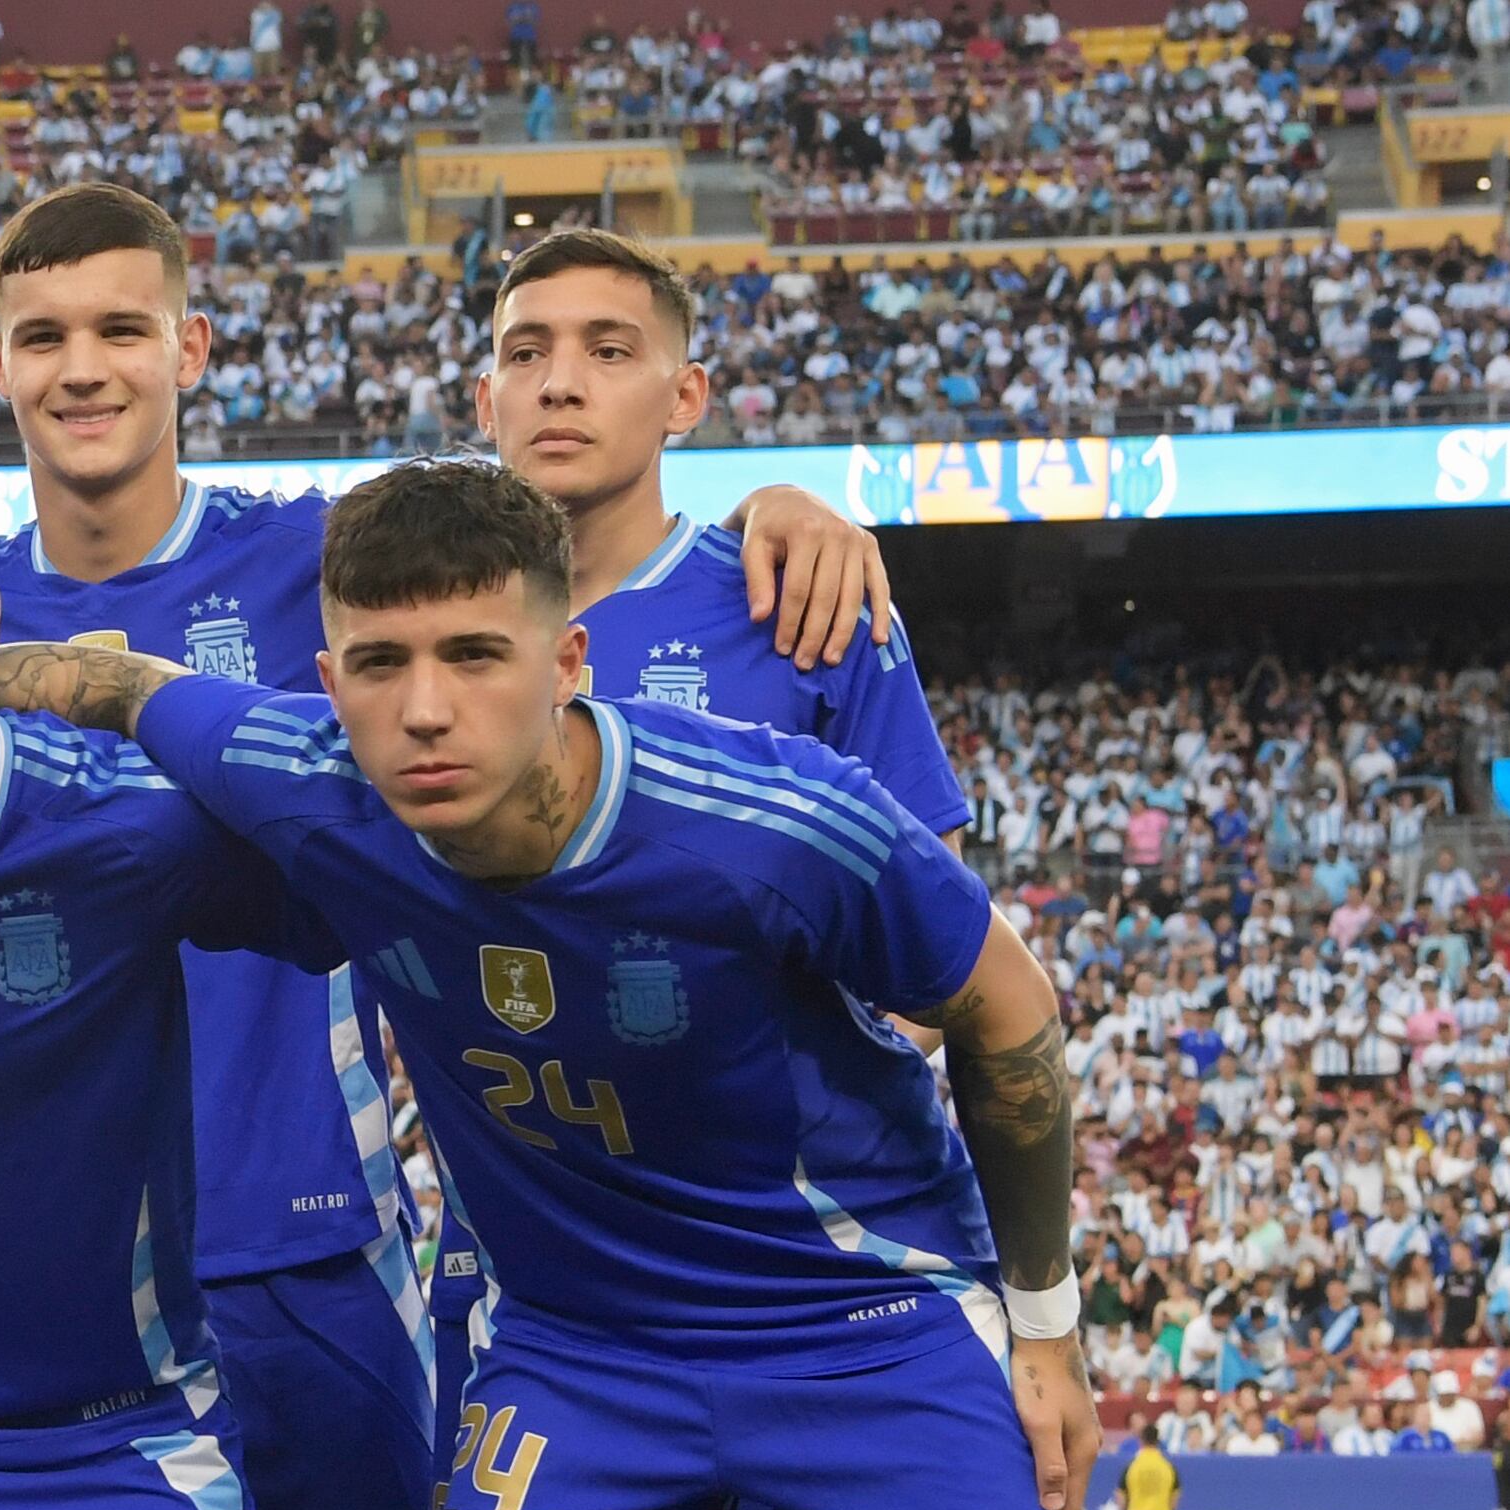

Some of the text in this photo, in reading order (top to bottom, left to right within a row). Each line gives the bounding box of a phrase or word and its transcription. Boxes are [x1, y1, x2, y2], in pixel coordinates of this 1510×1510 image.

[504, 999, 537, 1013] FIFA
[462, 1048, 634, 1155] 24
[292, 1193, 350, 1212] HEAT.RDY
[847, 1296, 919, 1323] HEAT.RDY
[81, 1388, 147, 1421] HEAT.RDY
